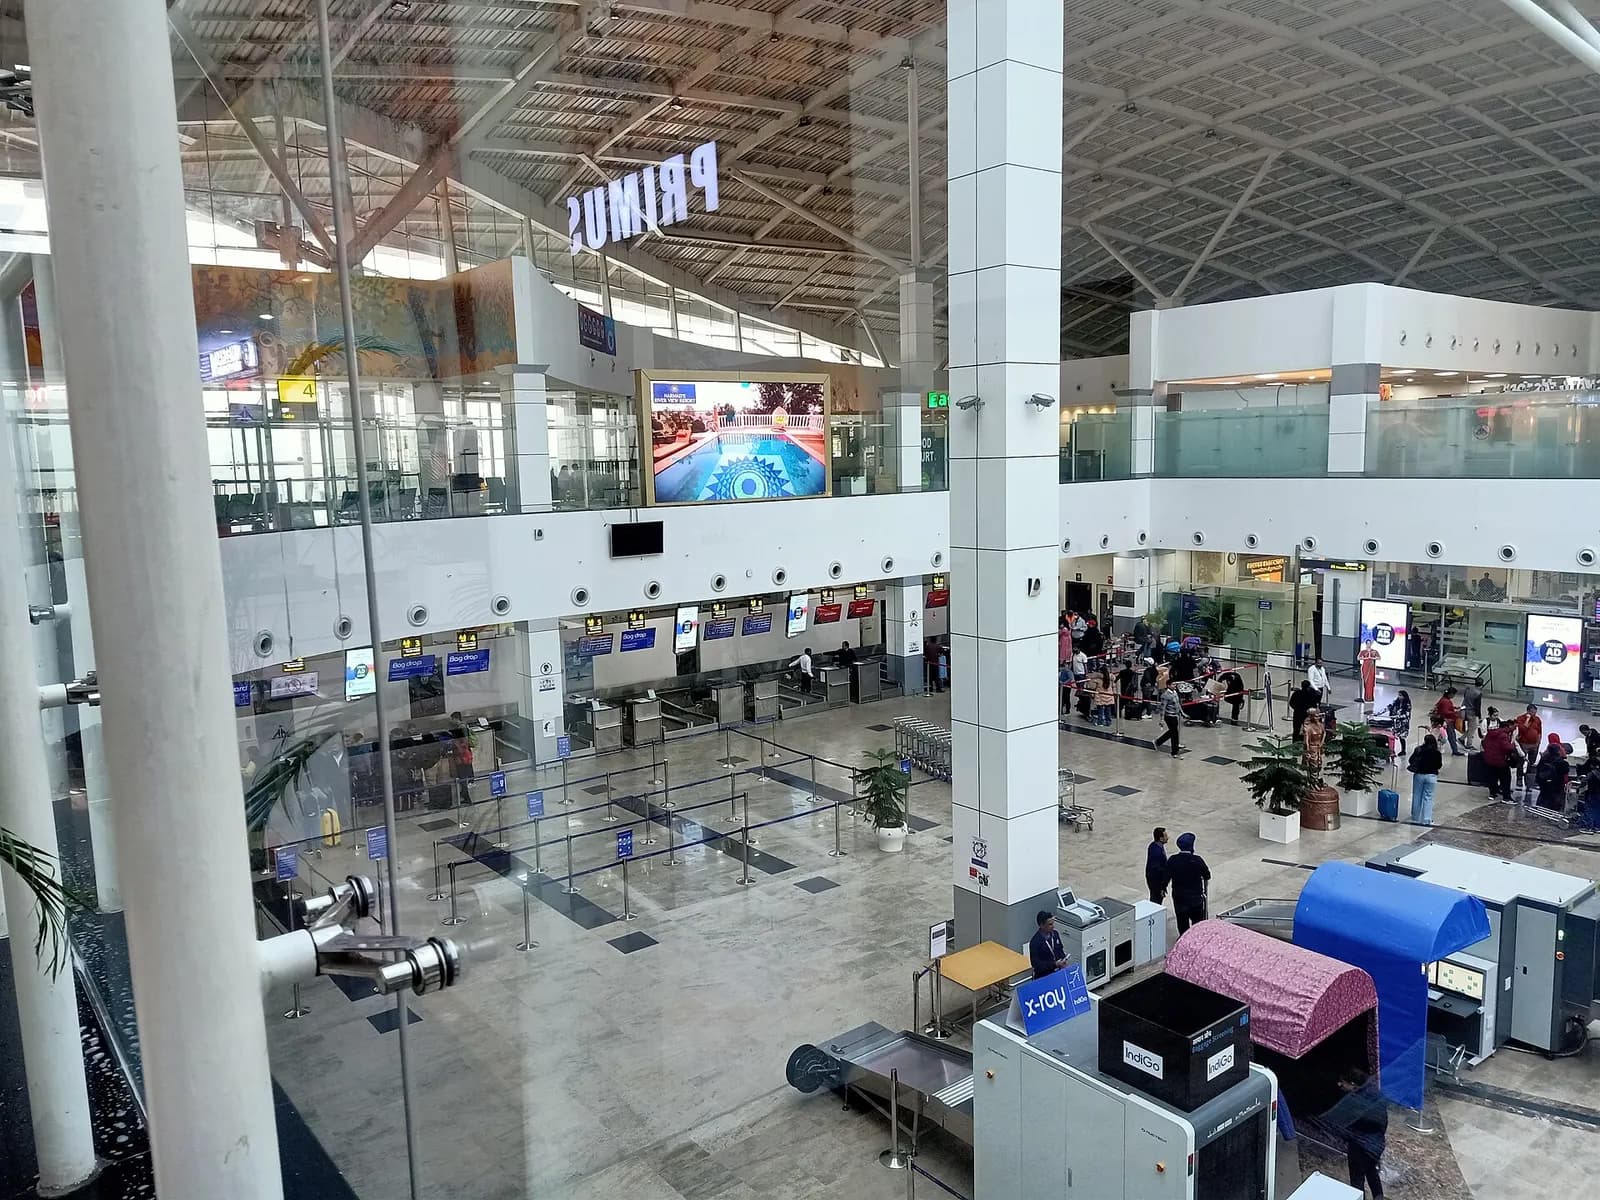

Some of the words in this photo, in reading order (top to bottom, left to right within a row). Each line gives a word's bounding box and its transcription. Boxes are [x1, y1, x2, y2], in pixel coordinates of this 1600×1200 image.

[302, 383, 315, 398] 4
[928, 391, 949, 409] Ea
[922, 437, 932, 449] OD
[921, 451, 934, 462] URT
[414, 639, 421, 647] 3
[449, 655, 464, 663] Bag
[1545, 649, 1562, 657] AD
[233, 685, 249, 693] ard
[1025, 986, 1066, 1018] x-ray
[1125, 1046, 1161, 1073] IndiGo
[1208, 1054, 1233, 1075] IndiGo
